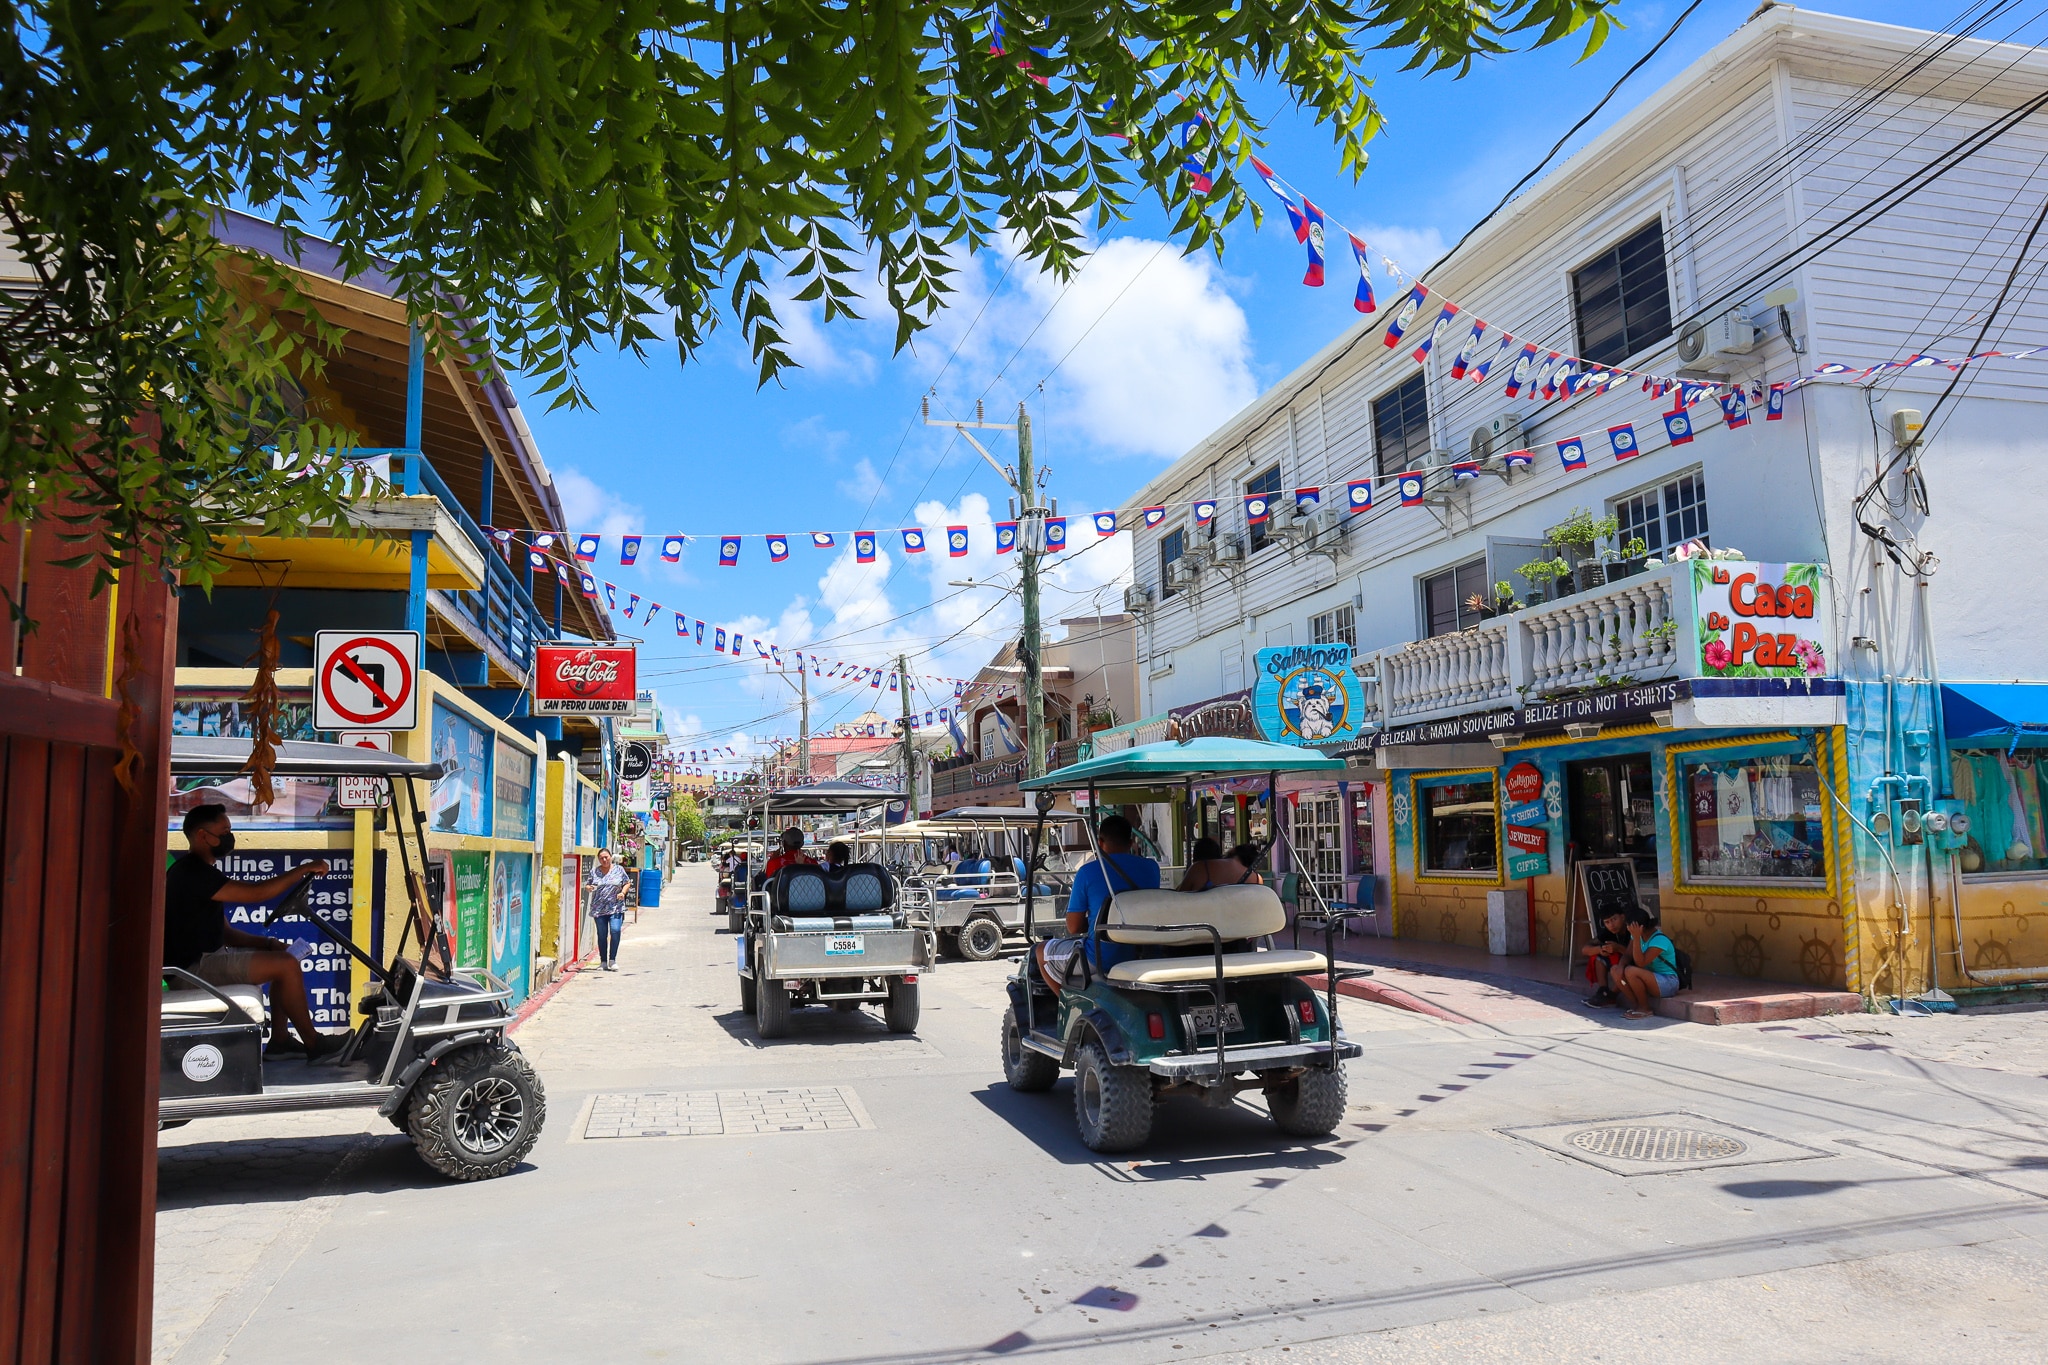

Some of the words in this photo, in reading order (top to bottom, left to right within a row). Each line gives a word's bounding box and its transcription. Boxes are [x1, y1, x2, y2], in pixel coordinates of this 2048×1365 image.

[1713, 565, 1730, 584] La
[1730, 572, 1814, 618] Casa
[1708, 611, 1730, 631] De
[1732, 621, 1798, 667] Paz
[1266, 646, 1312, 674] Salty
[544, 700, 559, 710] SAN
[561, 701, 586, 711] PEDRO
[588, 701, 610, 711] LIONS
[612, 701, 628, 711] DEN
[1380, 730, 1416, 746] BELIZEAN
[1430, 723, 1460, 739] MAYAN
[1462, 712, 1516, 734] SOUVENIRS
[1525, 704, 1559, 724] BELIZE
[1563, 702, 1573, 718] IT
[1577, 699, 1592, 715] OR
[1596, 694, 1618, 713] NOT
[1623, 683, 1677, 708] T-SHIRTS
[468, 728, 484, 760] DIVE
[345, 776, 360, 786] DO
[363, 776, 383, 786] NOT
[348, 789, 375, 799] ENTE
[1517, 806, 1540, 821] SHIRTS
[1508, 830, 1542, 846] JEWELRY
[213, 855, 275, 873] nline
[1516, 859, 1540, 873] GIFTS
[1590, 869, 1629, 892] OPEN
[833, 941, 857, 951] C5584
[300, 958, 352, 973] oans
